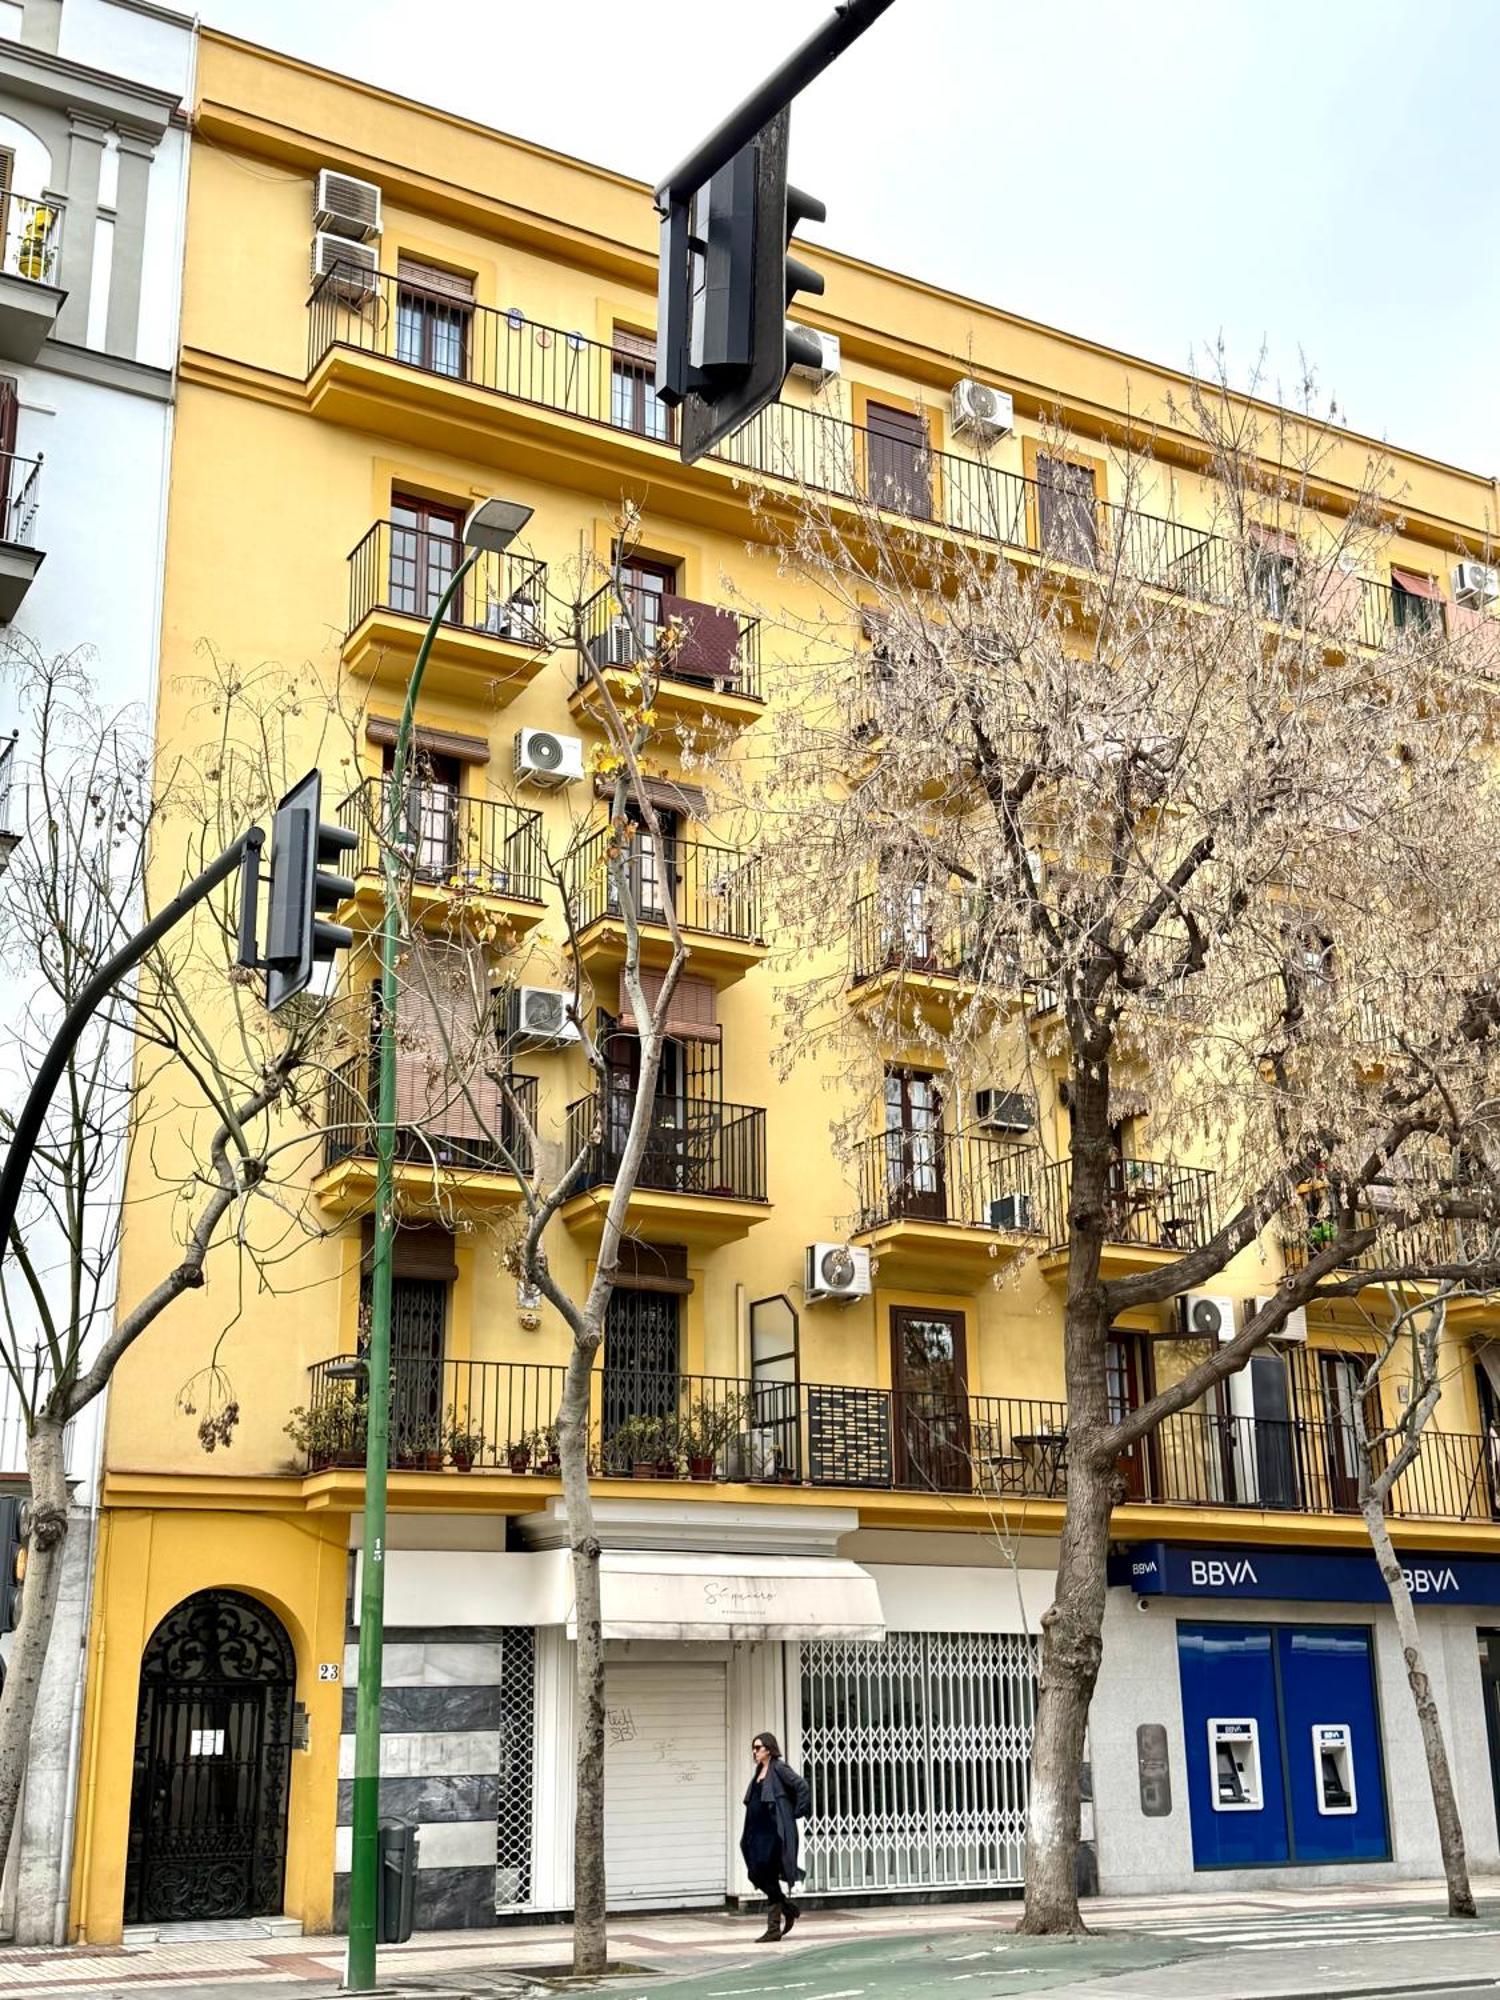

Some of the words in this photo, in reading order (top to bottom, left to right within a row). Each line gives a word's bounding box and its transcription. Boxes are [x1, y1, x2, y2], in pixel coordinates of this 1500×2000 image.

[1132, 1561, 1157, 1575] BBVA
[1191, 1559, 1258, 1586] BBVA
[1402, 1567, 1459, 1593] BBVA
[320, 1664, 338, 1680] 23
